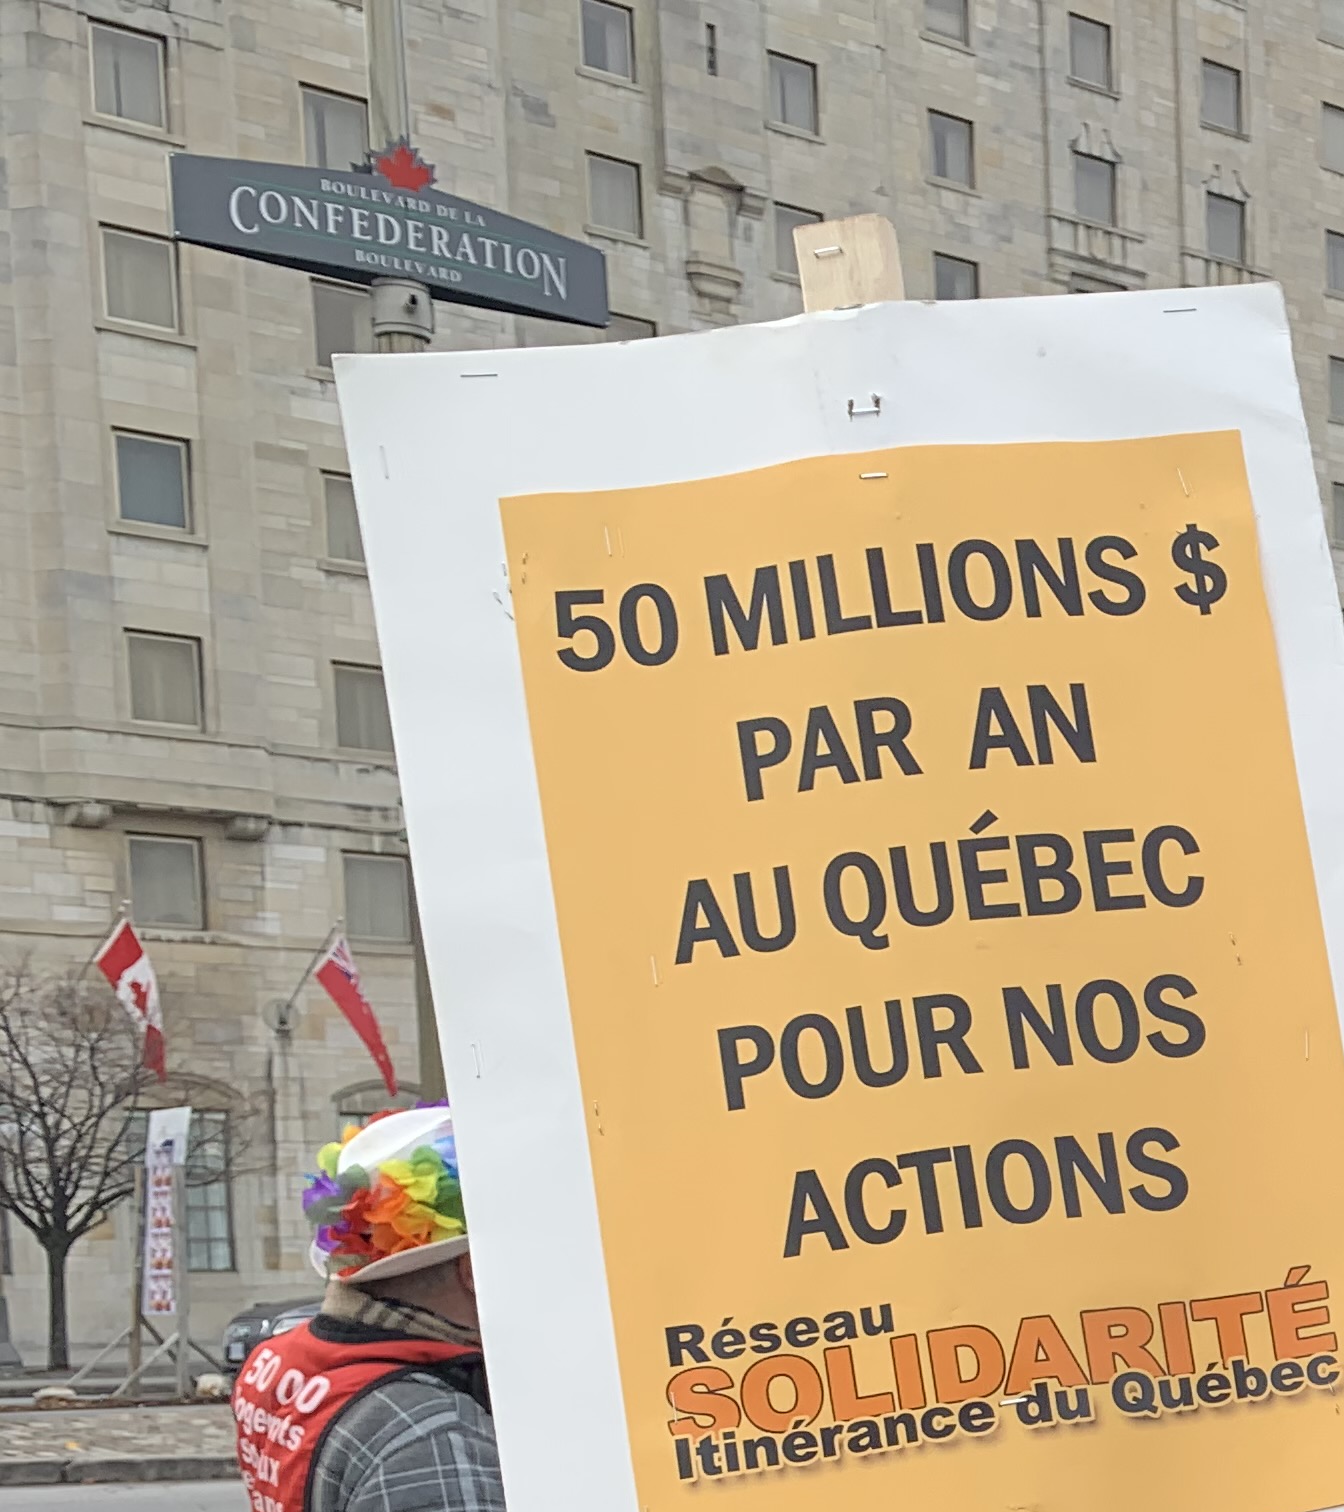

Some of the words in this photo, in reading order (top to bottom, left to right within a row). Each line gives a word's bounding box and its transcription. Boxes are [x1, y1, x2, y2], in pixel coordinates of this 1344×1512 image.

[229, 185, 568, 300] CONFEDERATION
[320, 178, 430, 214] BOULEVARD
[436, 204, 458, 221] DE
[464, 210, 486, 227] LA
[354, 249, 462, 283] BOULEVARD
[556, 584, 678, 671] 50
[704, 536, 1145, 655] MILLIONS
[1172, 524, 1226, 615] $
[738, 698, 922, 801] PAR
[970, 684, 1096, 769] AN
[676, 866, 795, 964] AU
[824, 810, 1203, 949] QUÉBEC
[718, 994, 983, 1110] POUR
[1002, 975, 1205, 1069] NOS
[784, 1128, 1188, 1257] ACTIONS
[244, 1348, 281, 1392] 50
[666, 1302, 894, 1367] Réseau
[667, 1264, 1338, 1438] SOLIDARITÉ
[675, 1396, 996, 1481] Itinérance
[1017, 1380, 1092, 1426] du
[1111, 1351, 1341, 1416] Québec
